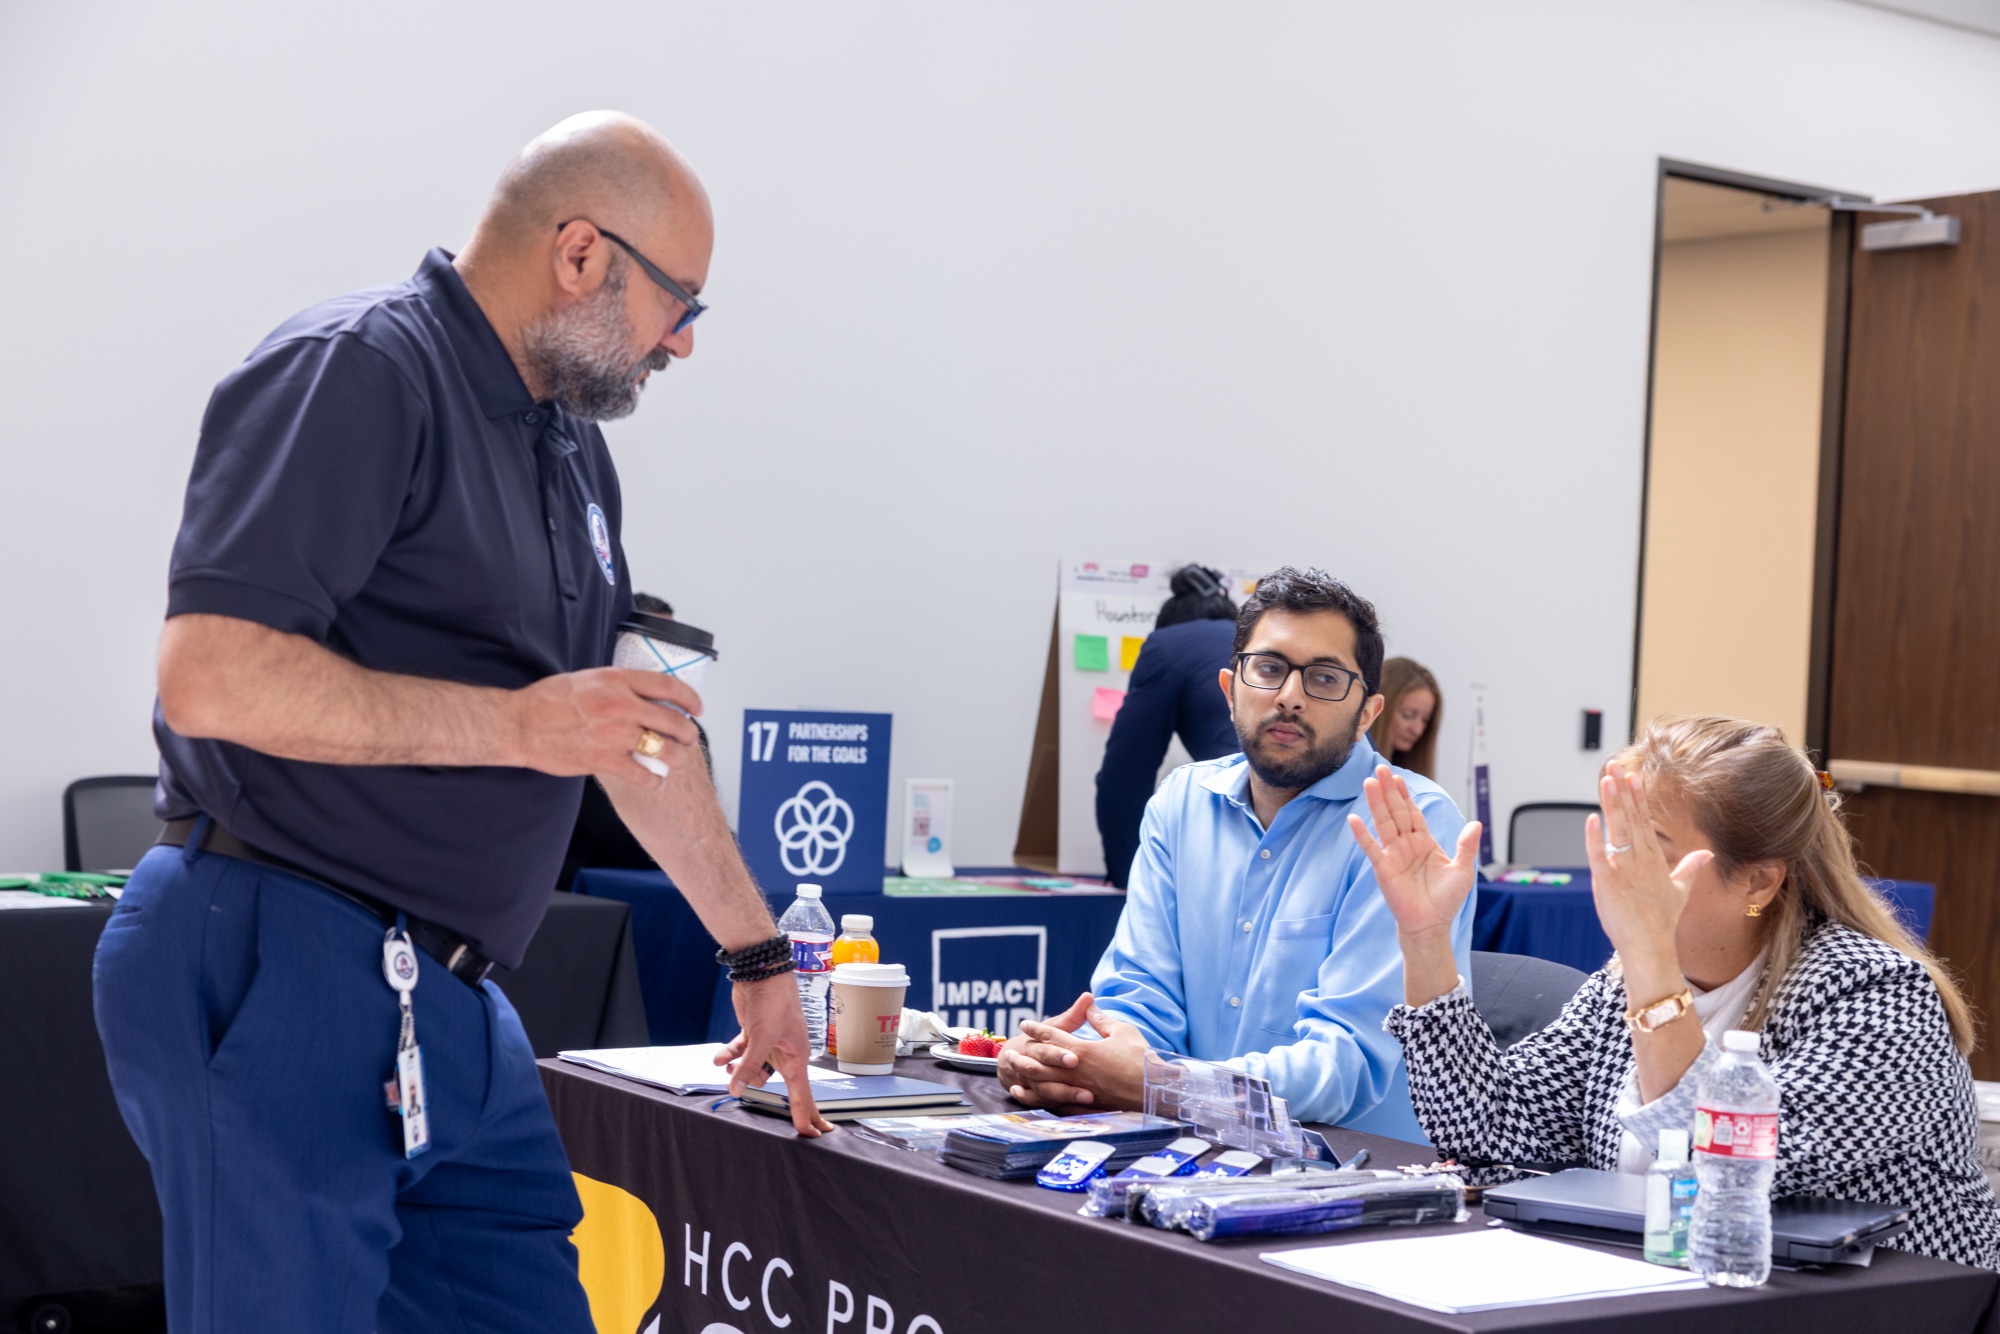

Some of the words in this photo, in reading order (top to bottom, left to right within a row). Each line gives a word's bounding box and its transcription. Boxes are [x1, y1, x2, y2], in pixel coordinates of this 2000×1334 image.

[748, 721, 779, 761] 17
[788, 722, 868, 741] PARTNERSHIPS
[787, 745, 810, 762] FOR
[811, 746, 831, 763] THE
[831, 746, 867, 764] GOALS
[939, 979, 1038, 1006] IMPACT
[684, 1222, 794, 1328] HCC
